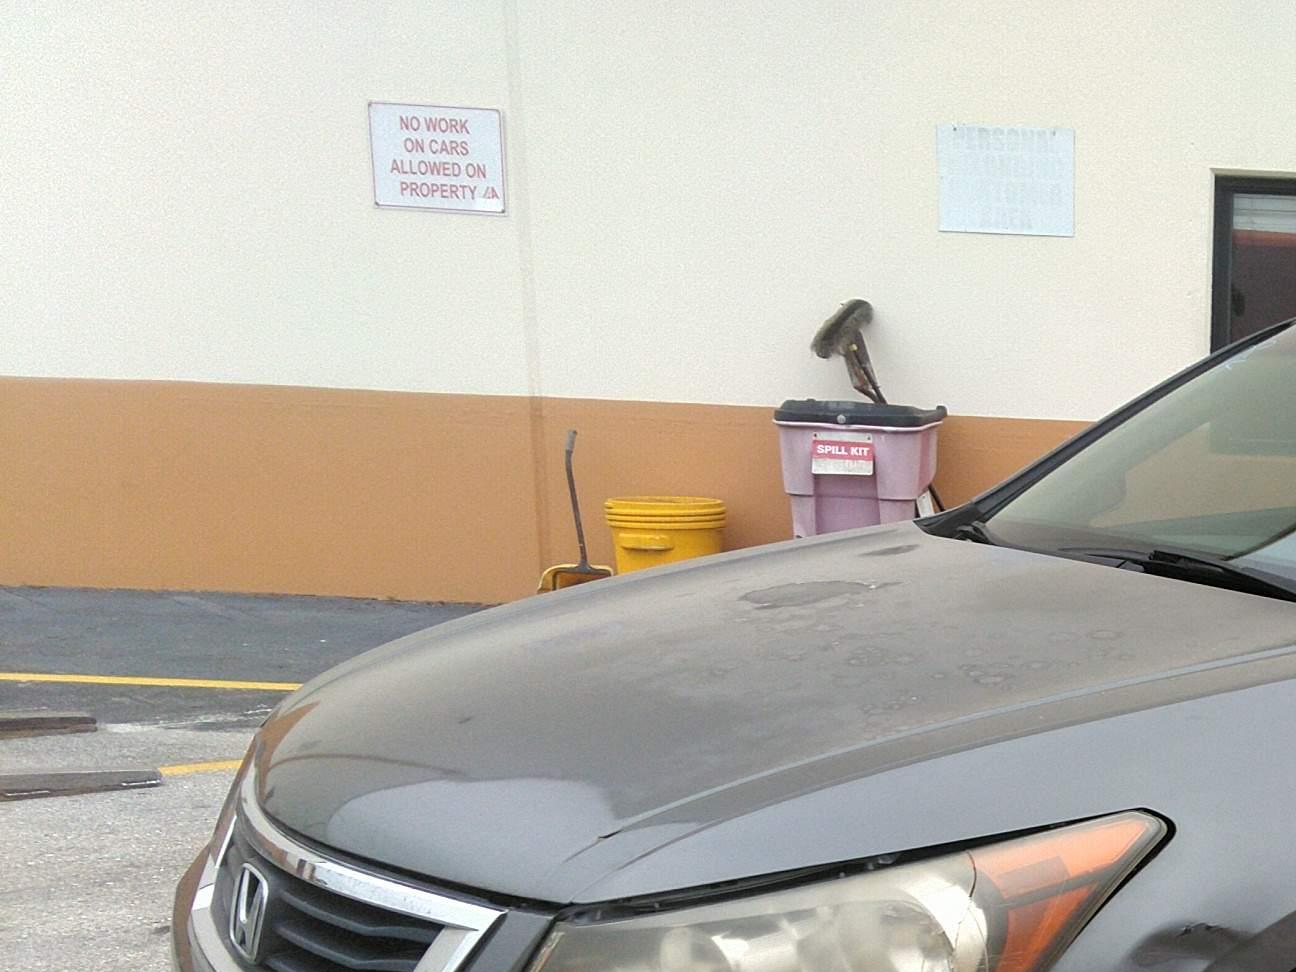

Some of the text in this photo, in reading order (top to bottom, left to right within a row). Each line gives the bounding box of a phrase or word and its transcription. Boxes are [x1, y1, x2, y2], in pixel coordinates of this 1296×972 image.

[400, 115, 470, 135] NO WORK
[404, 137, 469, 156] ON CARS
[390, 159, 486, 178] ALLOWED ON
[400, 181, 477, 200] PROPERTY
[817, 444, 869, 456] SPILL KIT
